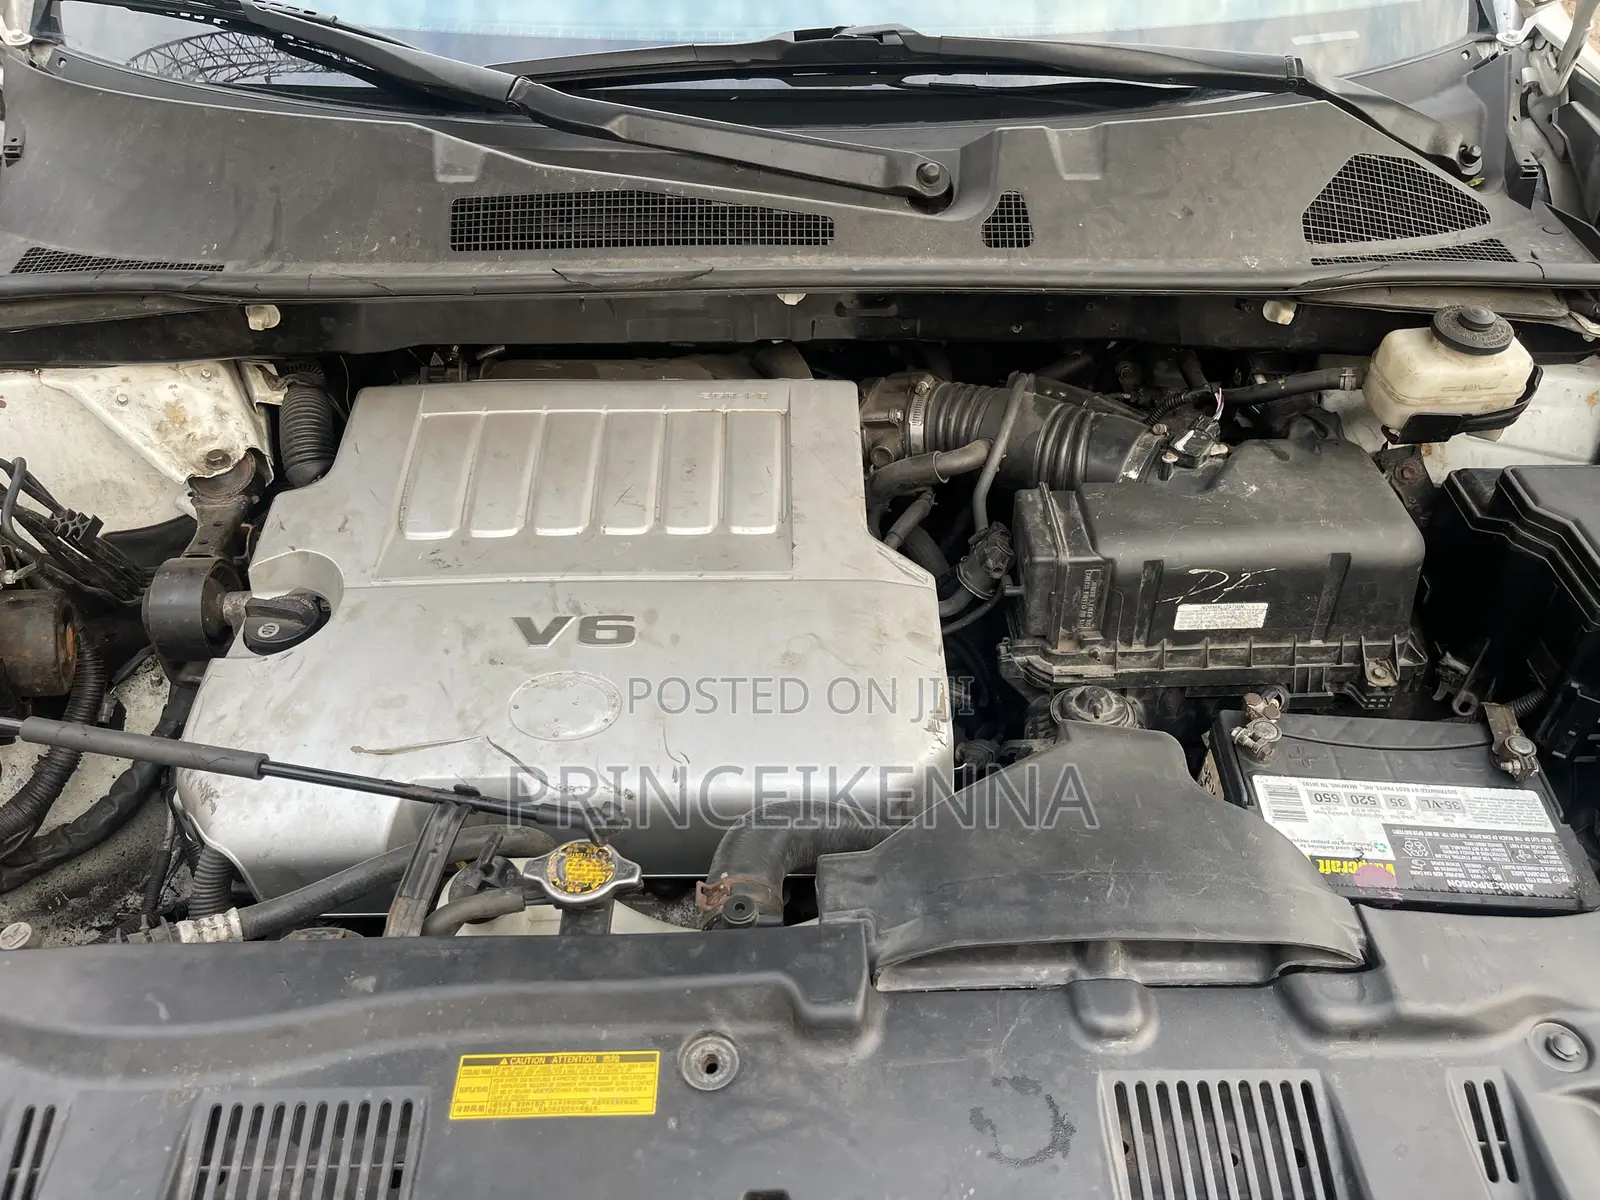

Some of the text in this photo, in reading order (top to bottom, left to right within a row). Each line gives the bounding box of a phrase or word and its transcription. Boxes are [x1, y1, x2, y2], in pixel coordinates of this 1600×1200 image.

[511, 615, 636, 649] V6
[1314, 793, 1340, 803] 650
[1350, 795, 1376, 805] 520
[1390, 798, 1406, 807] 35
[1421, 800, 1460, 810] 35-VL
[509, 1054, 597, 1065] CAUTION ATTENTION
